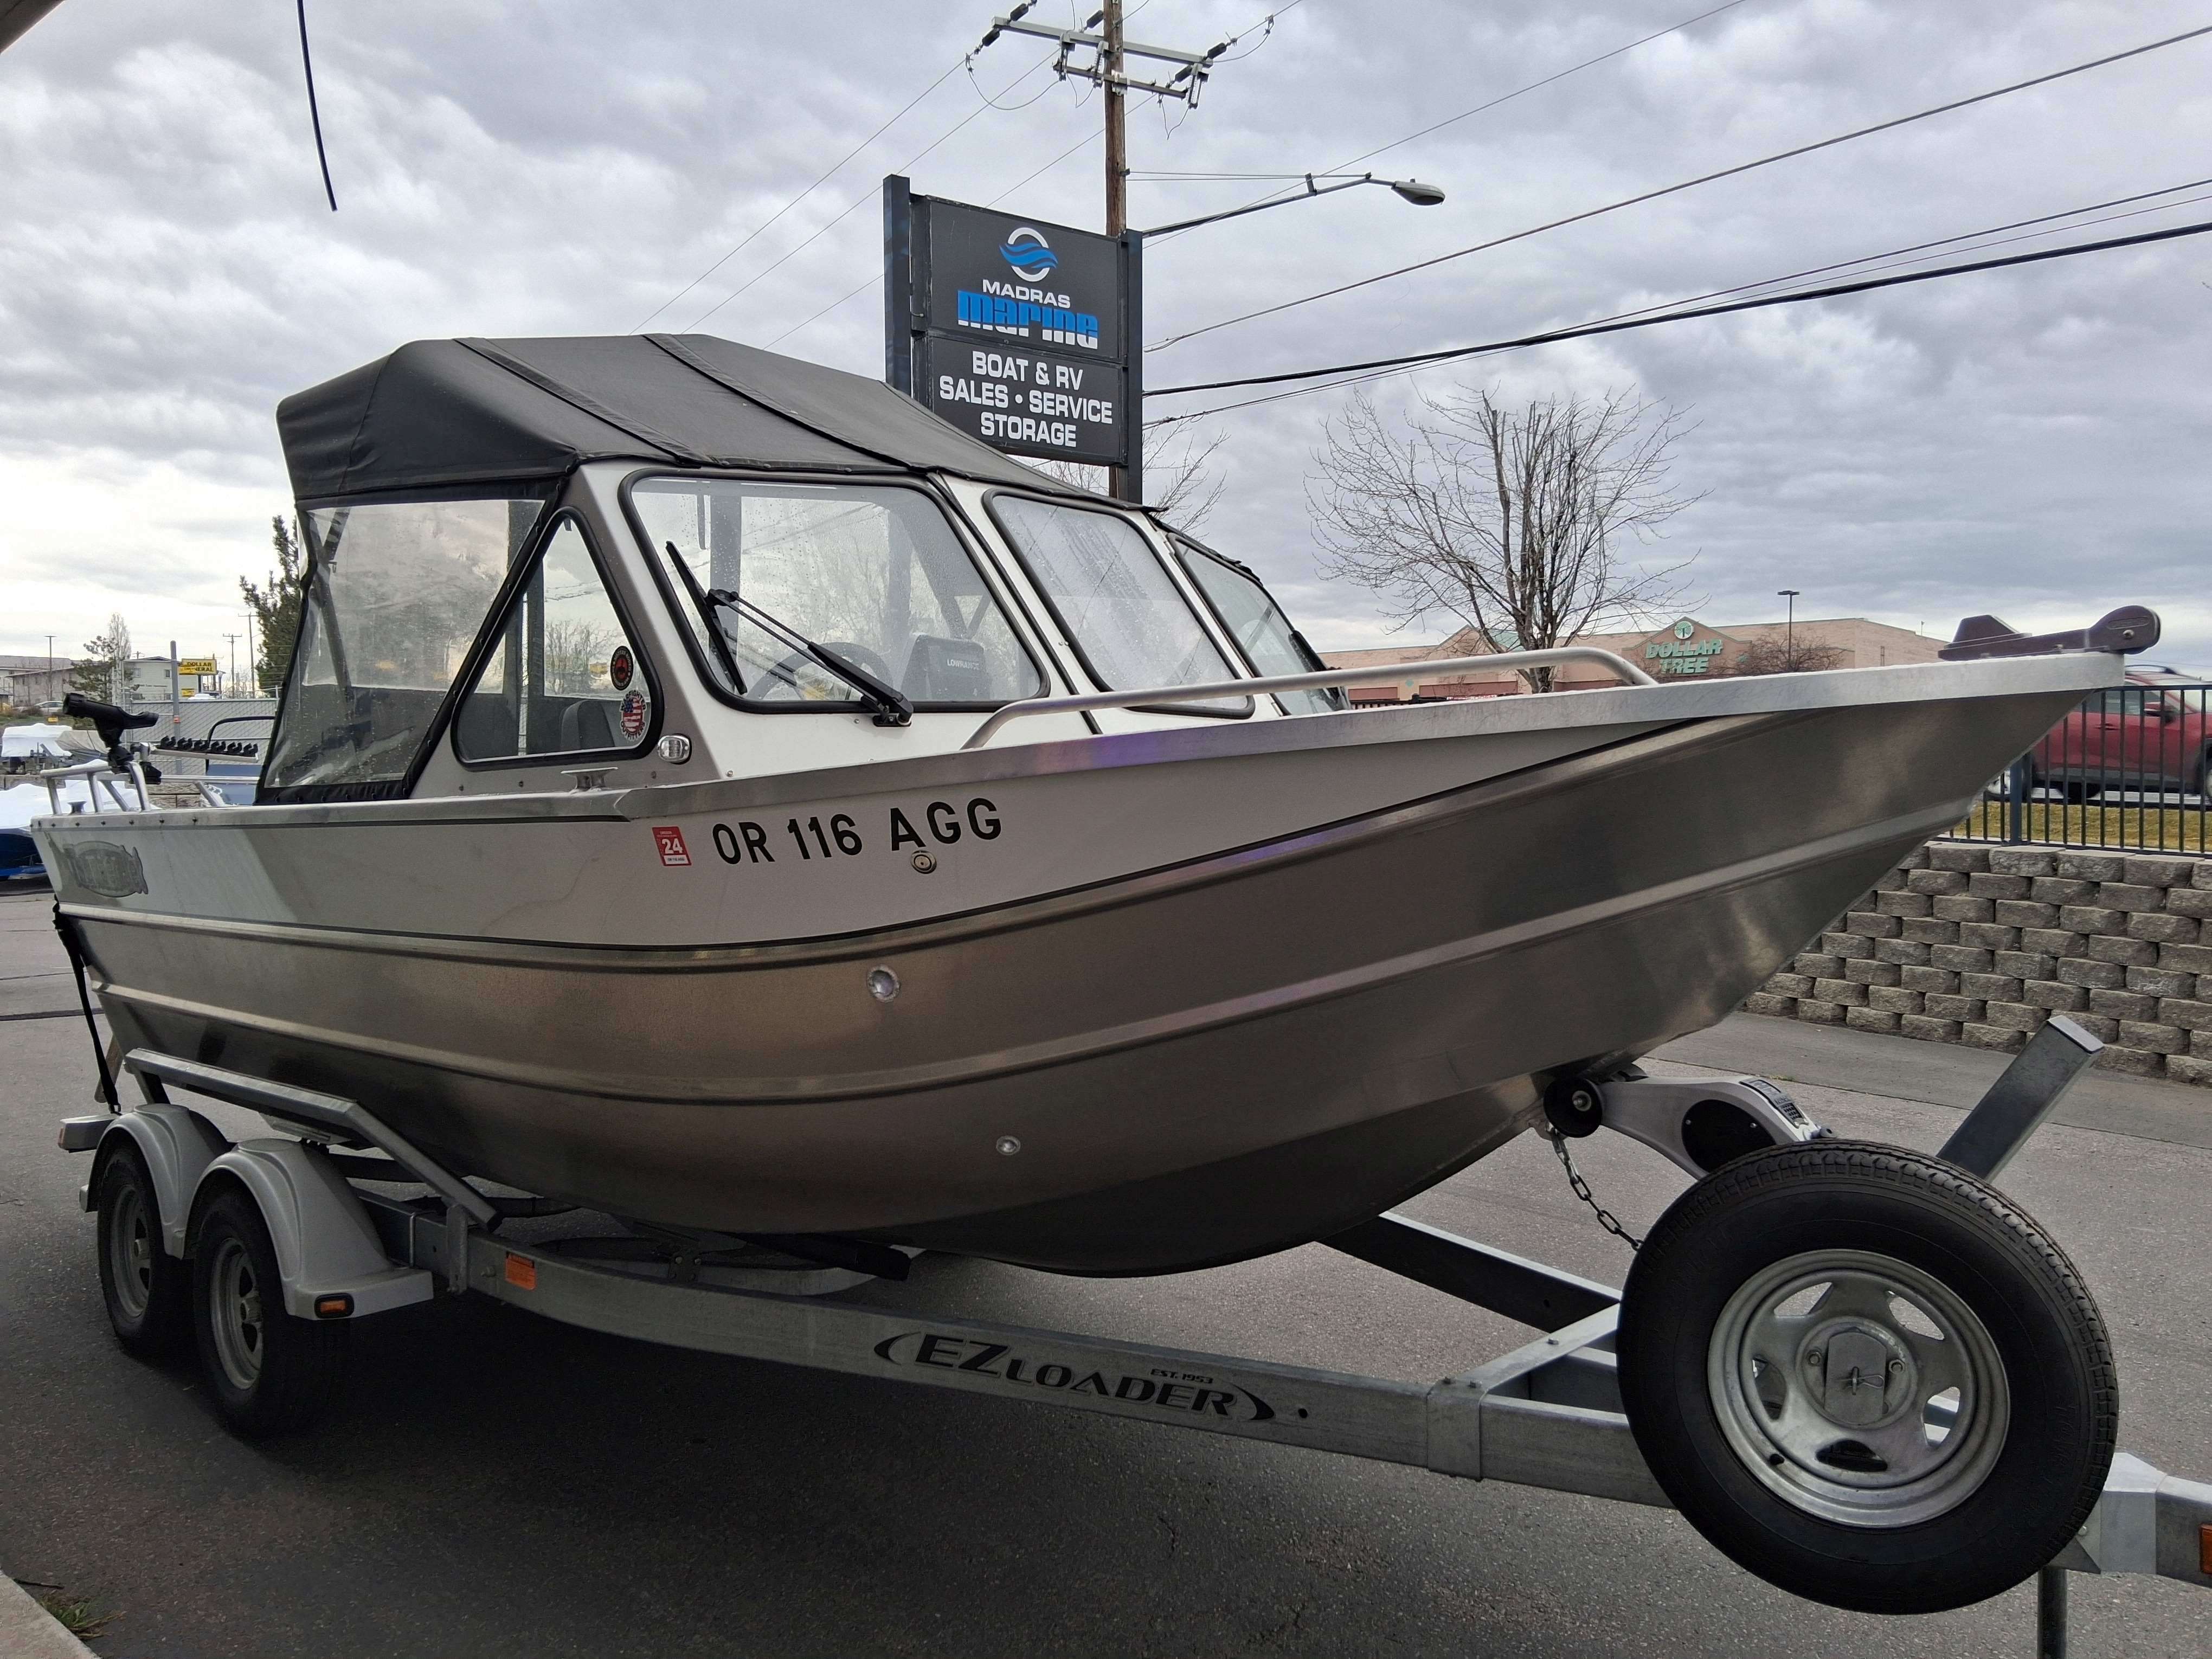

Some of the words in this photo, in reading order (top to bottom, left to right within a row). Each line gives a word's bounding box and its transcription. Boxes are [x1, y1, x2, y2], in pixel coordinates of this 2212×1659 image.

[982, 279, 1071, 309] MADRAS
[972, 351, 1028, 382] BOAT
[1036, 362, 1050, 387] &
[1056, 365, 1083, 390] RV
[939, 376, 1009, 408] SALES
[1028, 389, 1113, 425] SERVICE
[980, 411, 1077, 448] STORAGE
[1645, 639, 1723, 659] DOLLAR
[1660, 656, 1709, 674] TREE
[661, 838, 683, 854] 24
[712, 822, 775, 865] OR
[787, 814, 863, 860] 116
[890, 798, 1001, 851] AGG
[915, 1333, 1238, 1417] EZLOADER
[1150, 1368, 1179, 1379] EST.
